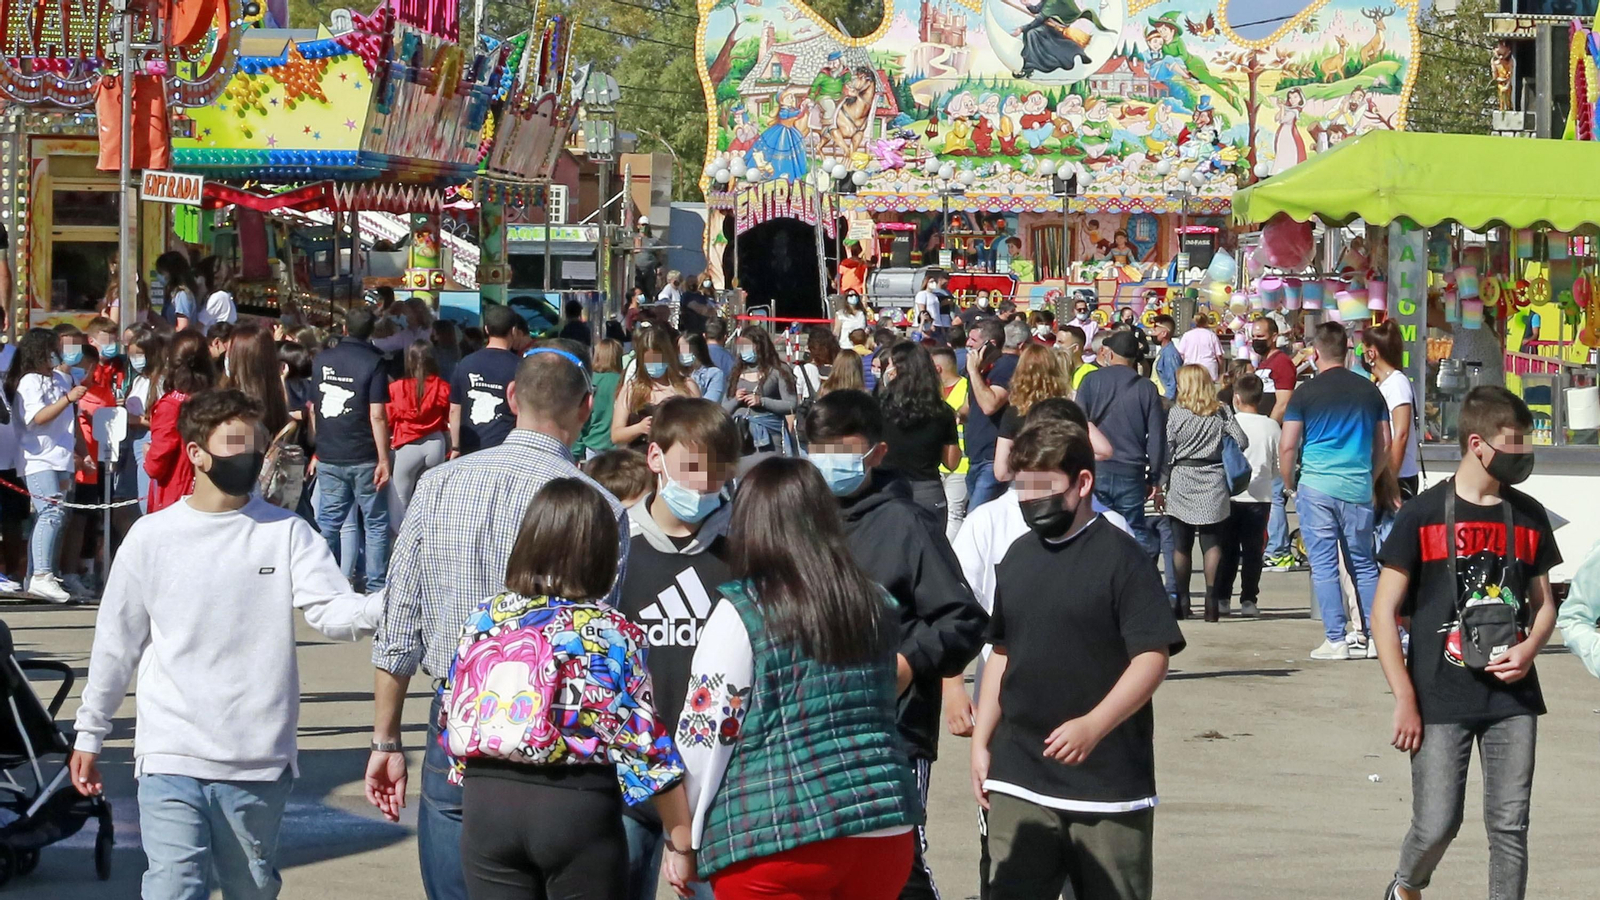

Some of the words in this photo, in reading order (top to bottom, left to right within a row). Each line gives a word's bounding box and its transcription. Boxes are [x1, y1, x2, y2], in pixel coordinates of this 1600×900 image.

[144, 173, 200, 200] ENTRADA
[737, 178, 838, 239] ENTRADA
[1398, 219, 1417, 383] PALOMI
[640, 617, 703, 647] did
